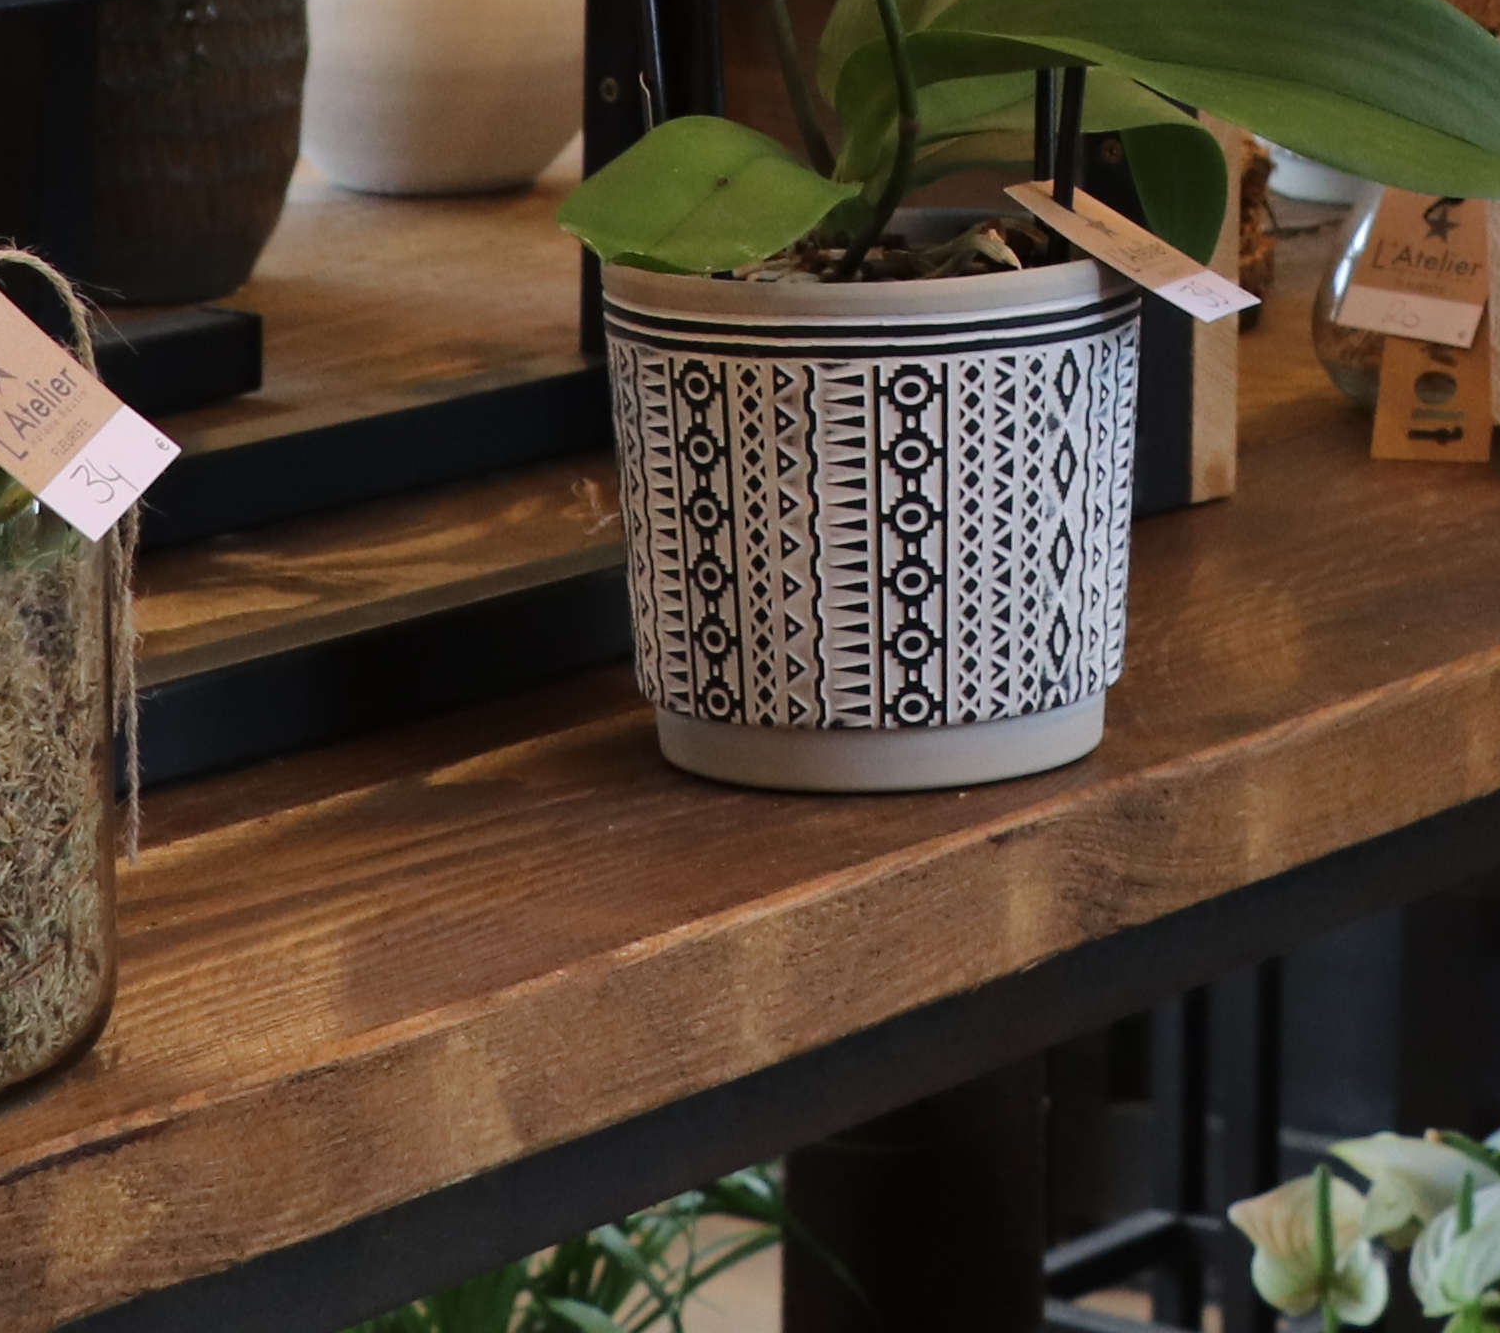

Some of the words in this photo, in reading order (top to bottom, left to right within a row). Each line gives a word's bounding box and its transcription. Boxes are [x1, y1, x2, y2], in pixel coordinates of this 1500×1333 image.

[1372, 239, 1481, 277] L'Atelier
[52, 417, 93, 458] FLEURISTE
[70, 457, 139, 504] 34
